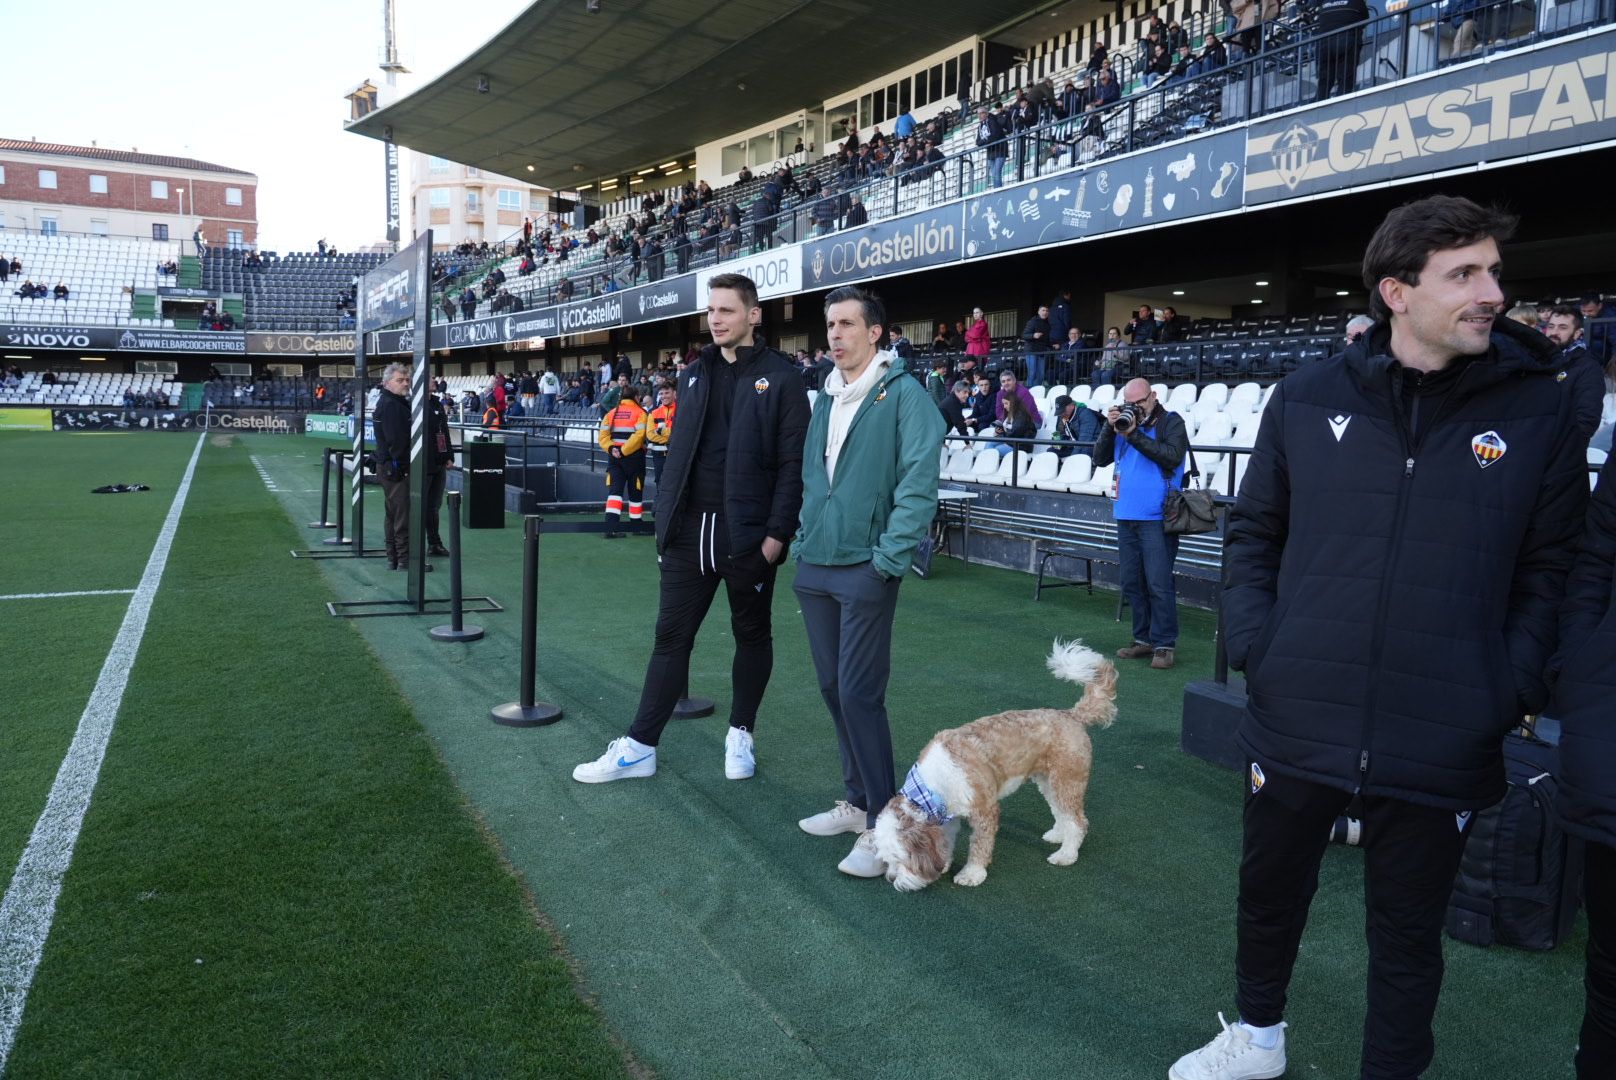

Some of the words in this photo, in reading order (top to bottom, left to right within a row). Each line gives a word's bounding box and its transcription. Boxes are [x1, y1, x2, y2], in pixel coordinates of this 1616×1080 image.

[389, 169, 399, 216] ESTRELLA
[23, 334, 90, 347] NOVO
[138, 339, 246, 350] WWW.ELBARCOOCHENTERO.ES
[277, 336, 355, 352] CDCastelló
